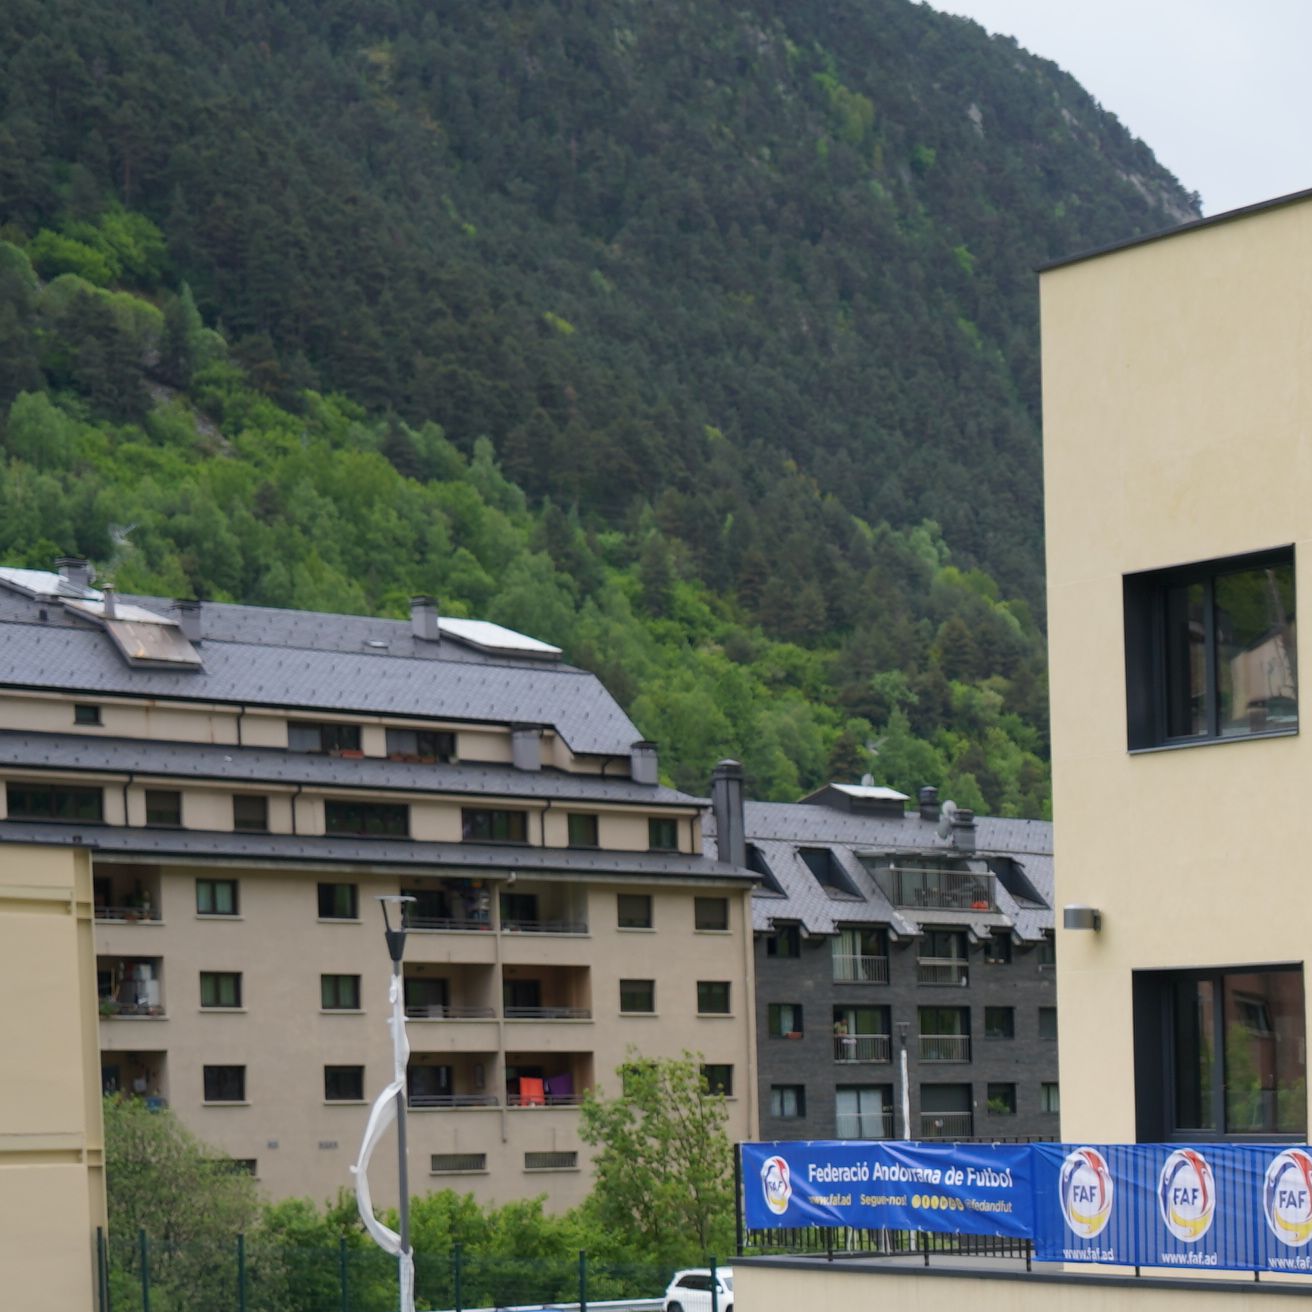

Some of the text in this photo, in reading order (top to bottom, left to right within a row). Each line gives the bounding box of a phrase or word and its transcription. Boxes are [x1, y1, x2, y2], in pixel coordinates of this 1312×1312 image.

[808, 1161, 869, 1183] Federació
[873, 1162, 941, 1185] Andorrana
[944, 1165, 964, 1186] de
[1073, 1185, 1098, 1203] FAF
[1174, 1187, 1200, 1206] FAF
[1279, 1190, 1307, 1209] FAF
[1063, 1247, 1114, 1262] www.faf.ad
[1161, 1251, 1217, 1266] www.faf.ad
